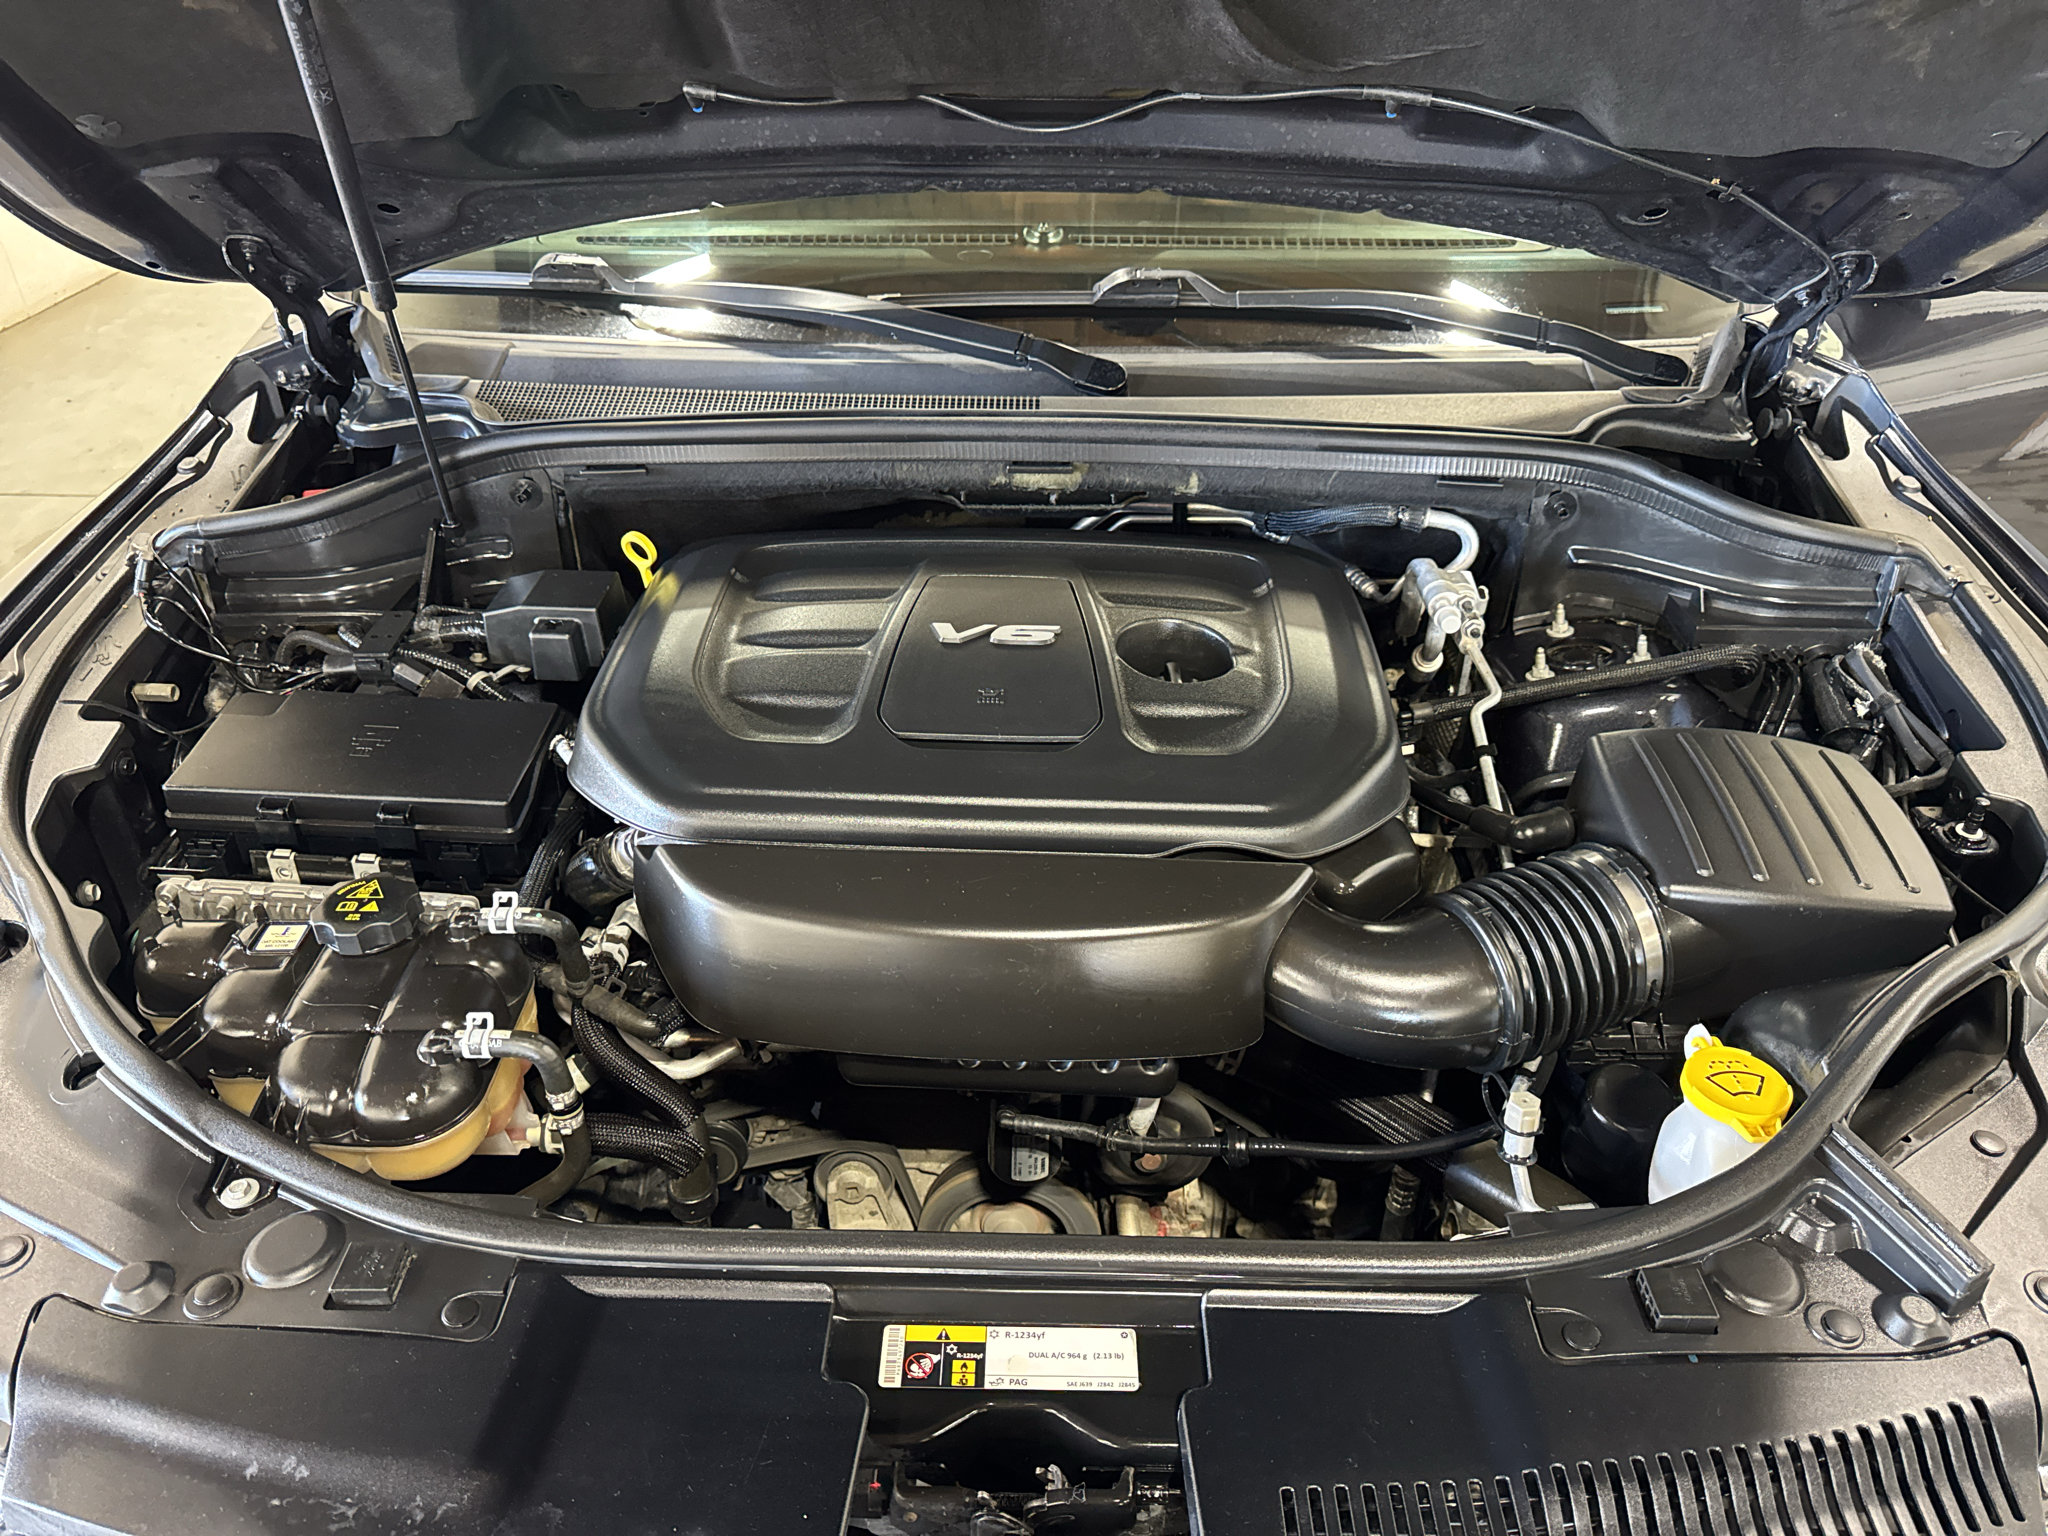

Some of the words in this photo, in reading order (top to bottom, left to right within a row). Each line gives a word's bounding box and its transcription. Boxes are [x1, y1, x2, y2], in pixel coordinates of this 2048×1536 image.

[929, 622, 1062, 646] V6
[1005, 1331, 1046, 1340] R-1234yf
[1093, 1352, 1113, 1360] (2.13
[1114, 1352, 1125, 1360] lb)
[1009, 1378, 1028, 1386] PAG
